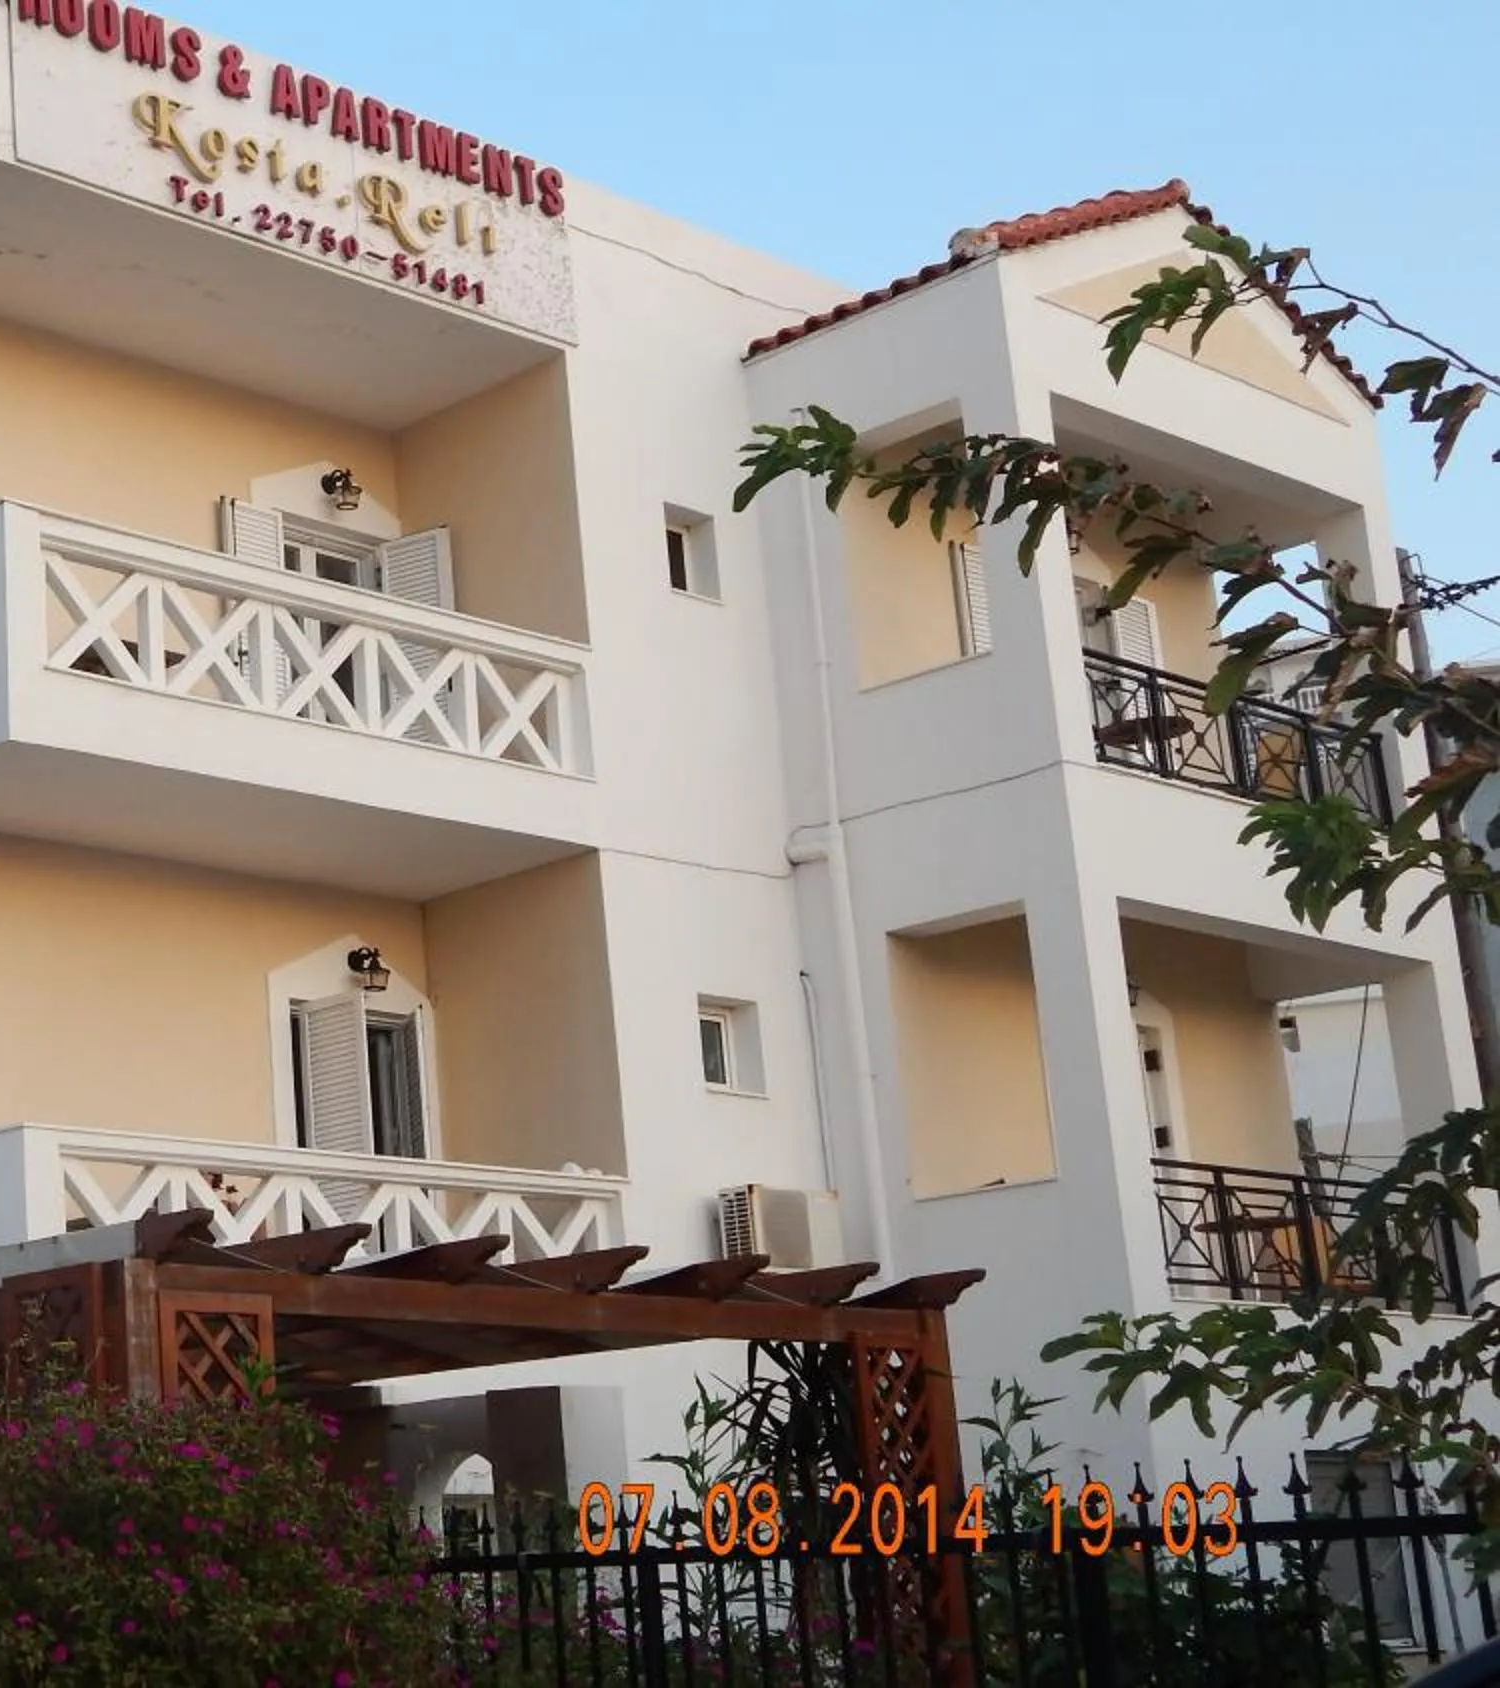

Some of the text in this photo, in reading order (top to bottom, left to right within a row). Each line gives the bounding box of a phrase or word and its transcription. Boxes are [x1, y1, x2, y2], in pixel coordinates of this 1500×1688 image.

[217, 44, 251, 99] &
[270, 63, 566, 217] APARTMENTS
[169, 175, 241, 224] Tel.
